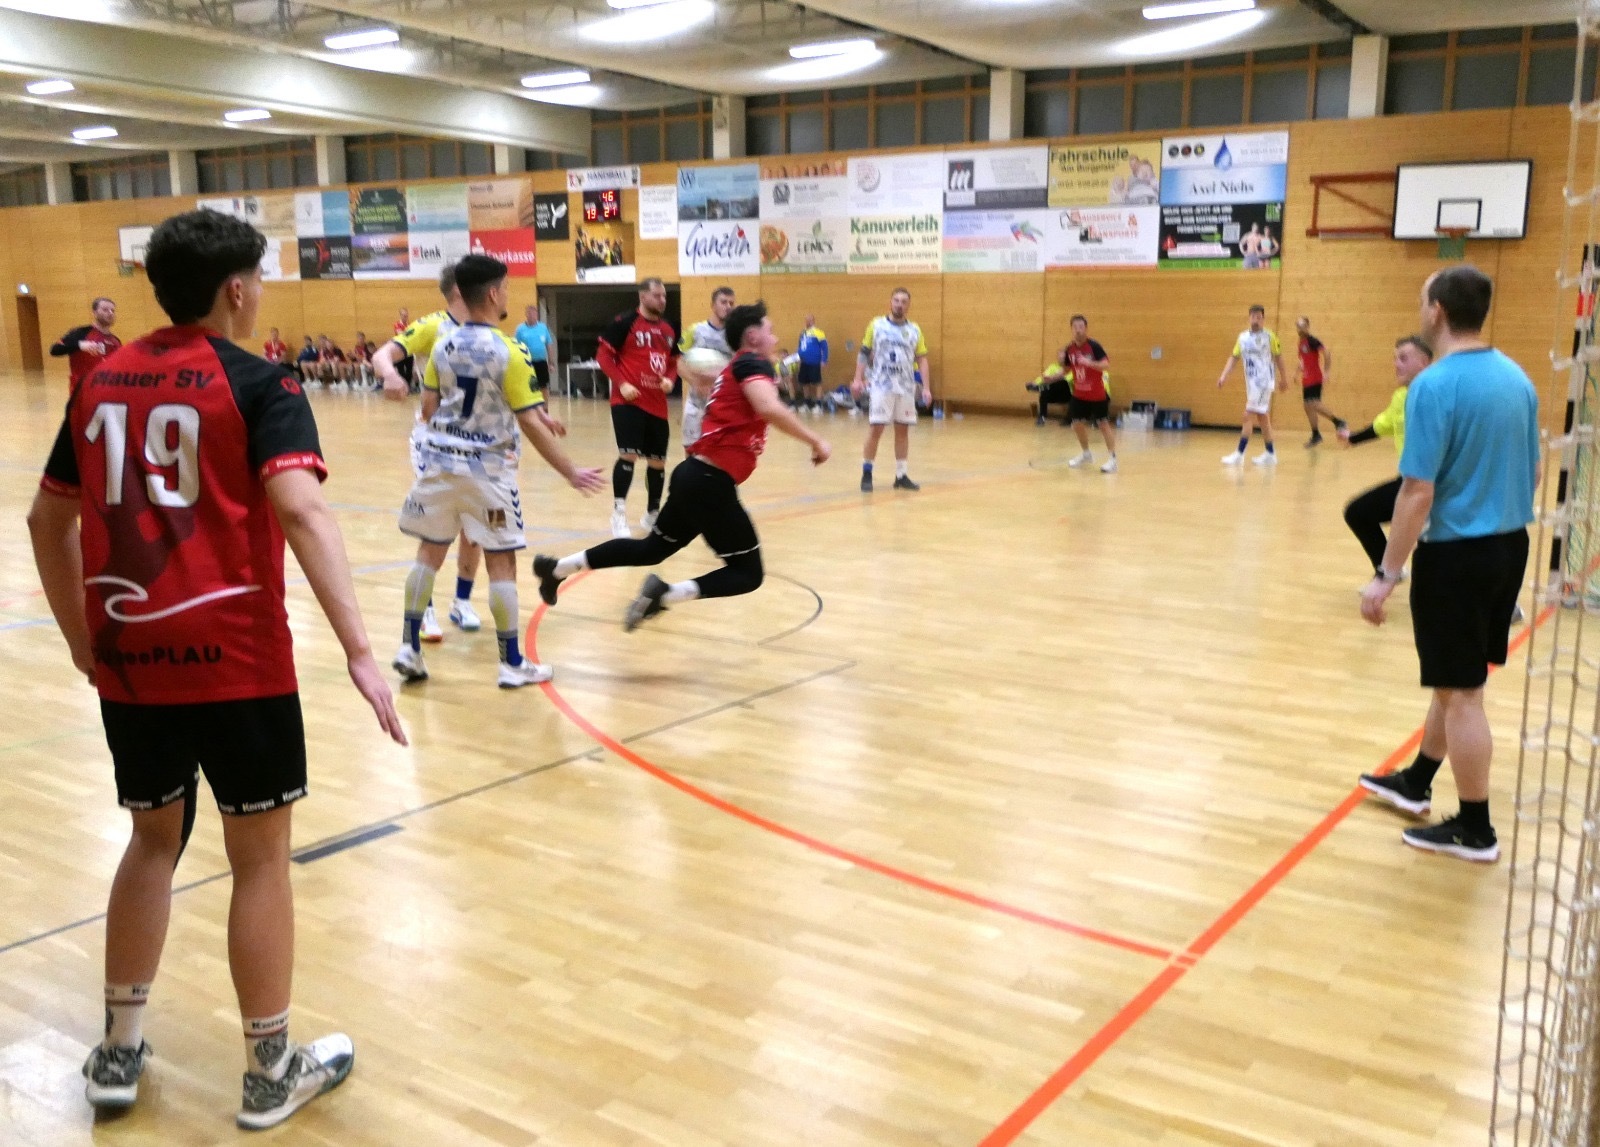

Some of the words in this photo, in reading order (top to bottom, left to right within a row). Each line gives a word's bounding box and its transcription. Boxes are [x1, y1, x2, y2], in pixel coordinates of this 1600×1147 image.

[1050, 146, 1129, 163] Fahrschule
[1191, 181, 1217, 195] Axel
[602, 191, 614, 202] 46
[586, 208, 597, 220] 19
[604, 206, 617, 218] 21
[850, 214, 939, 234] Kanuverleih
[893, 236, 914, 247] Kajak
[420, 244, 442, 260] lenk
[175, 369, 214, 389] SV
[456, 376, 479, 418] 7
[84, 402, 200, 508] 19
[301, 454, 314, 465] SV
